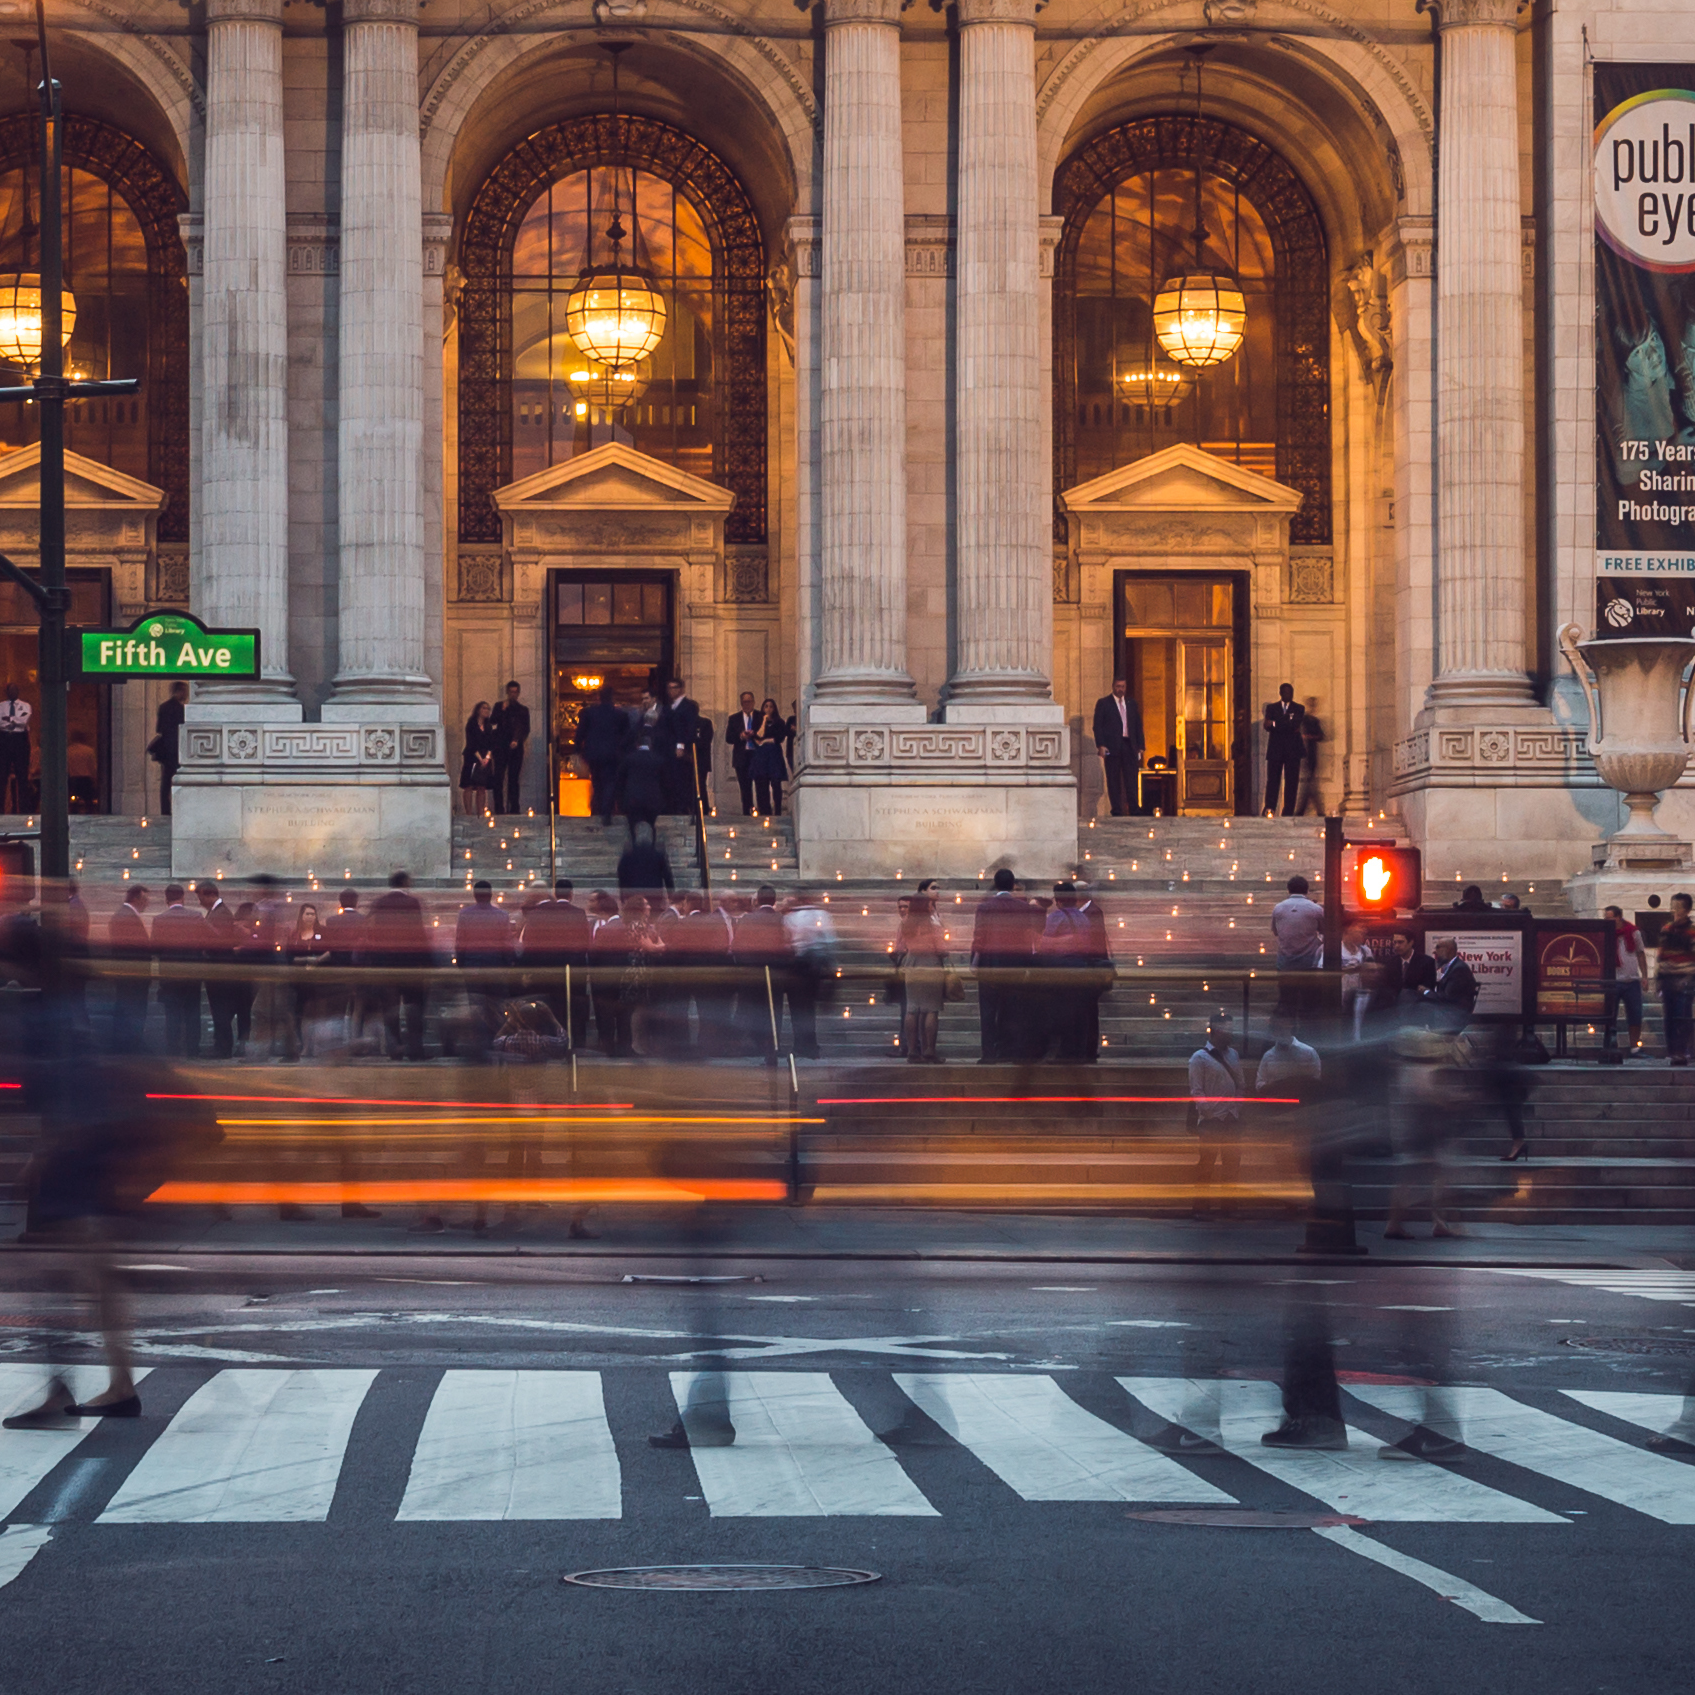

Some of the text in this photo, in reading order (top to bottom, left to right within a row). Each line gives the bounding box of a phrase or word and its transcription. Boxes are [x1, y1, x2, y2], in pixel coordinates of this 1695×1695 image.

[1620, 440, 1649, 461] 175
[1605, 558, 1643, 571] FREE
[1636, 607, 1665, 617] Library
[100, 640, 232, 668] Fifth Ave
[1457, 951, 1512, 962] New York
[1471, 963, 1514, 977] Library
